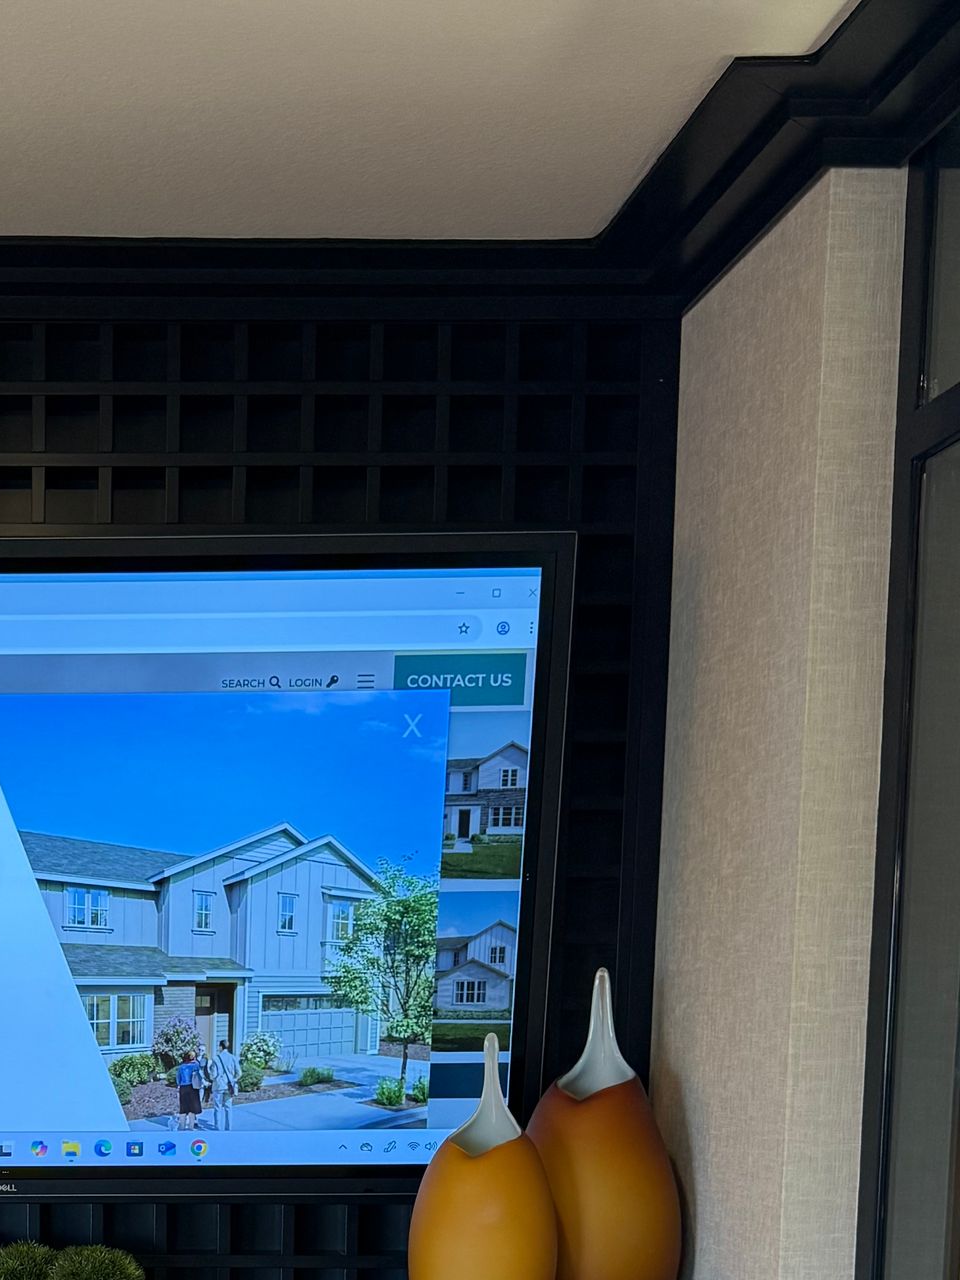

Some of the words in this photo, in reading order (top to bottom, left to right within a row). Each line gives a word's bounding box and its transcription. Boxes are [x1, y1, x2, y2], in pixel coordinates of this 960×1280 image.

[221, 679, 266, 689] SEARCH
[288, 678, 323, 688] LOGIN
[406, 674, 486, 689] CONTACT
[489, 673, 512, 688] US
